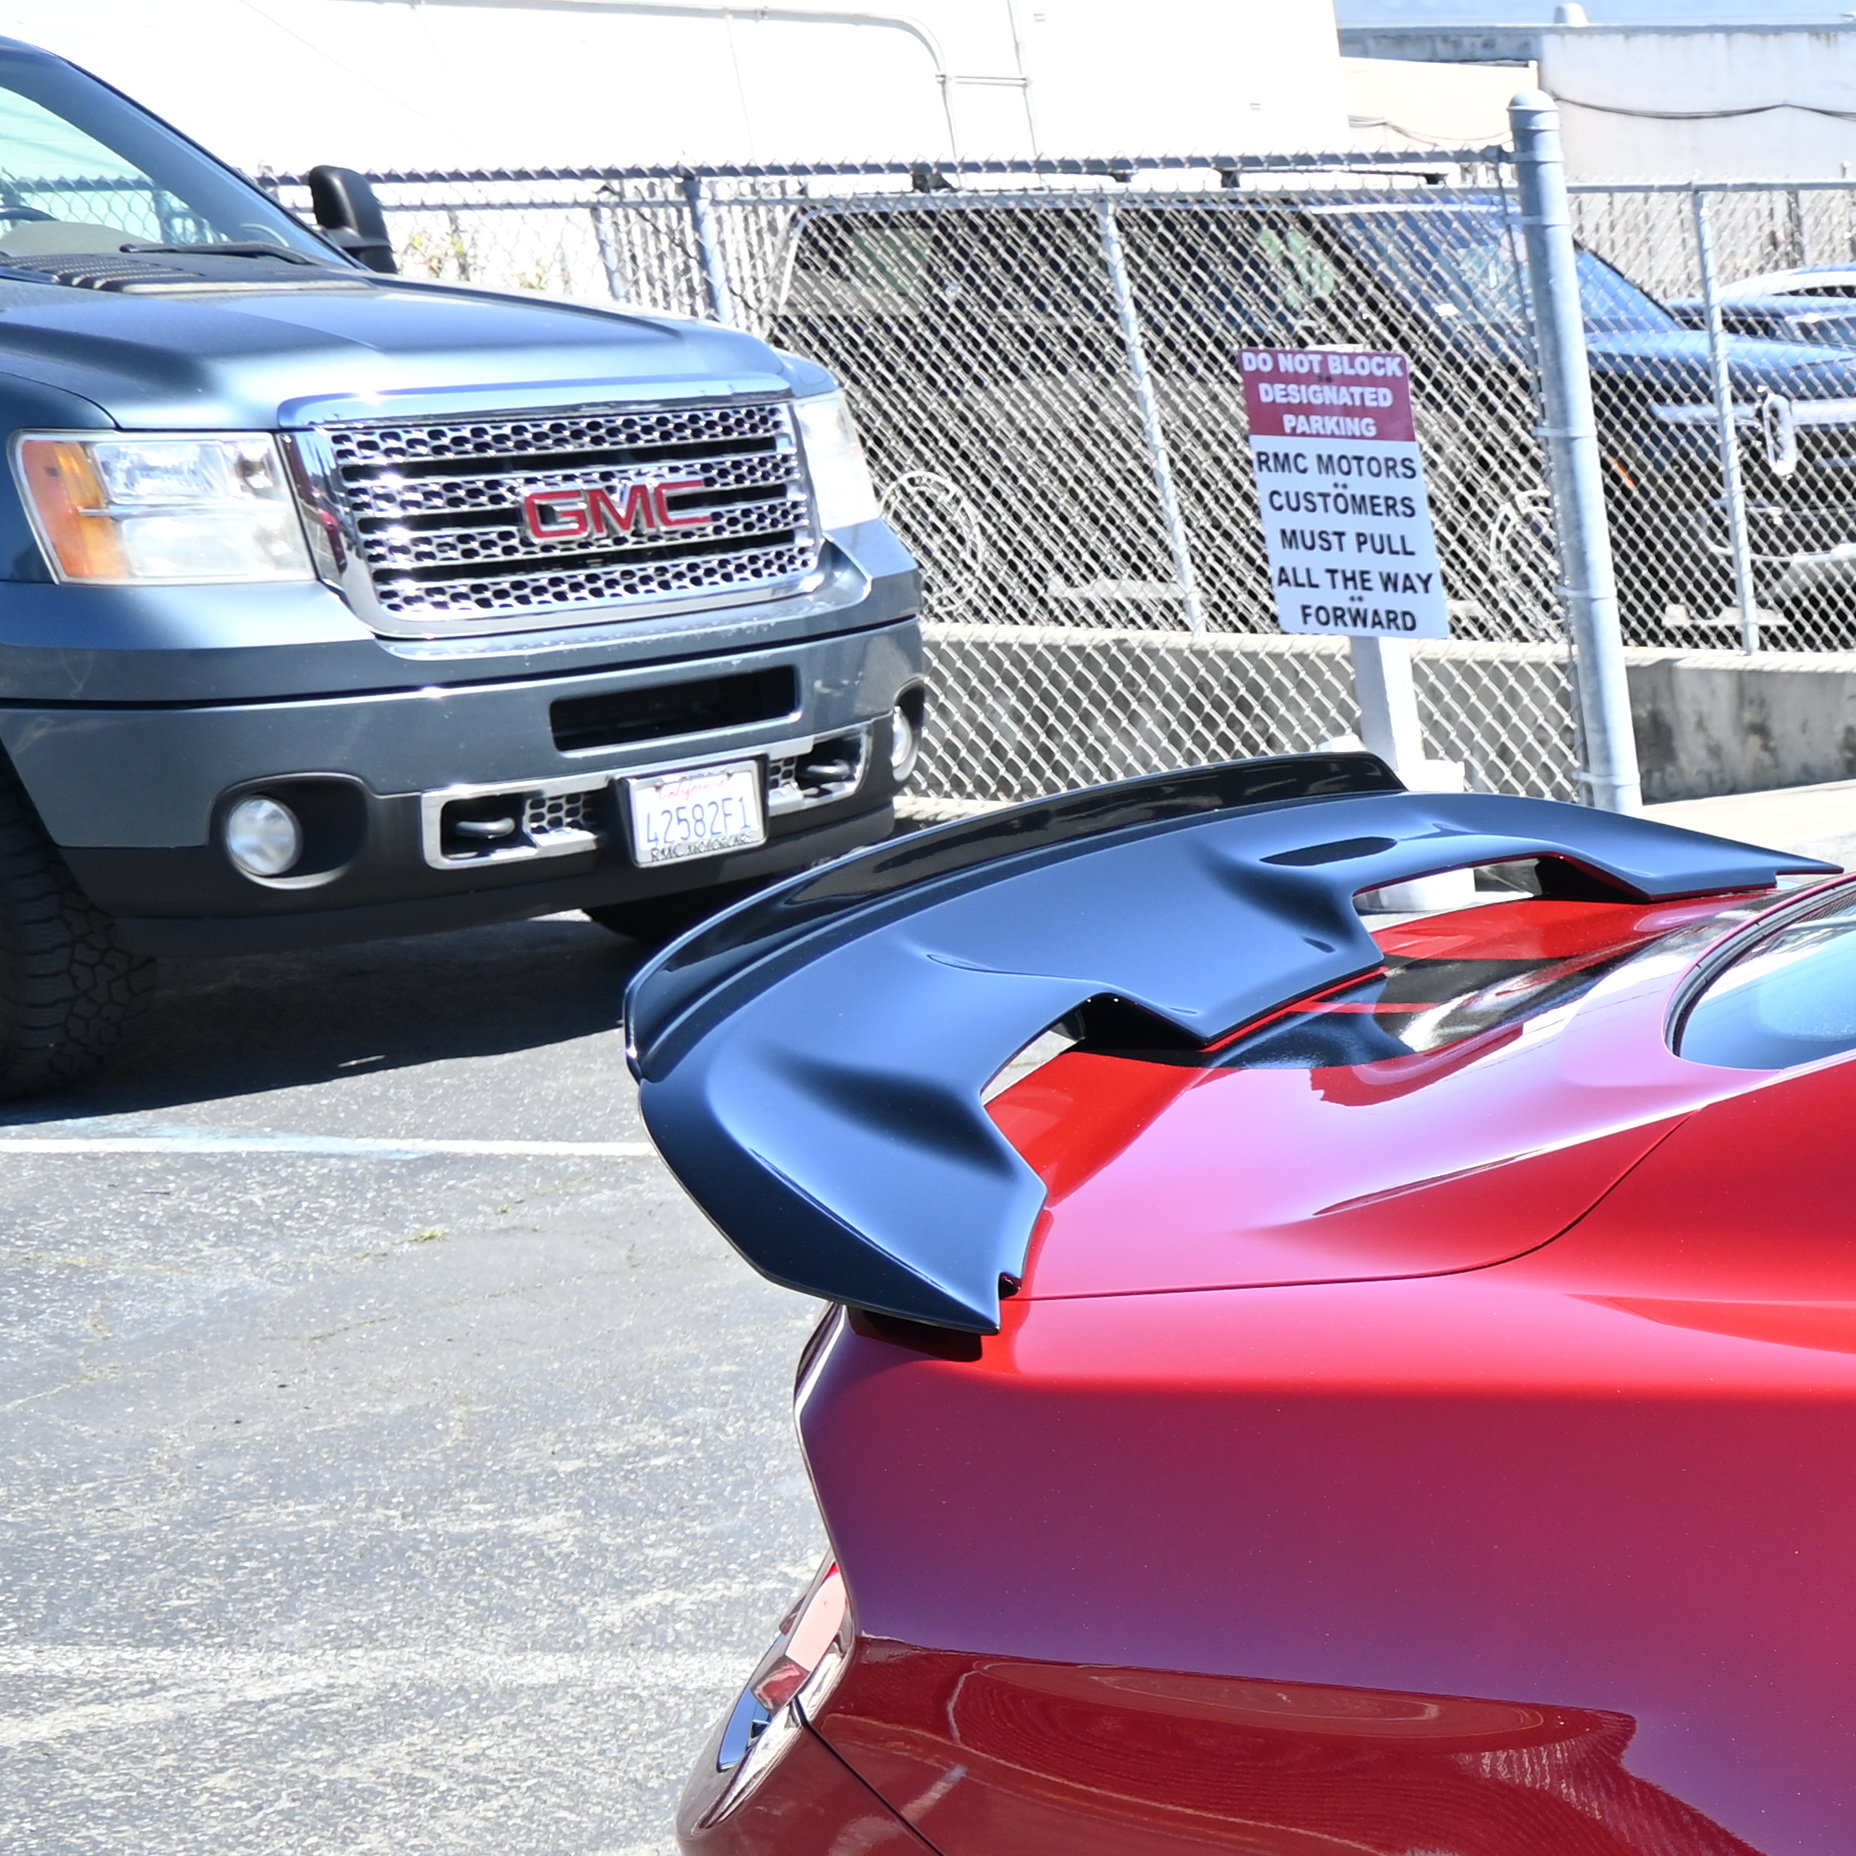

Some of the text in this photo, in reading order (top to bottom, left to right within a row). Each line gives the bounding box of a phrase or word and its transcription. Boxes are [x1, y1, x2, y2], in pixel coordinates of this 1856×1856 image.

[1241, 352, 1404, 377] DO NOT BLOCK
[1258, 383, 1393, 408] DESIGNATED
[1282, 414, 1377, 437] PARKING
[1256, 451, 1417, 479] RMC MOTORS
[524, 479, 714, 540] GMC
[1268, 490, 1416, 518] CUSTOMERS
[1280, 528, 1416, 556] MUST PULL
[1277, 566, 1433, 594] ALL THE WAY
[1301, 604, 1417, 631] FORWARD
[647, 796, 750, 847] 42582F1
